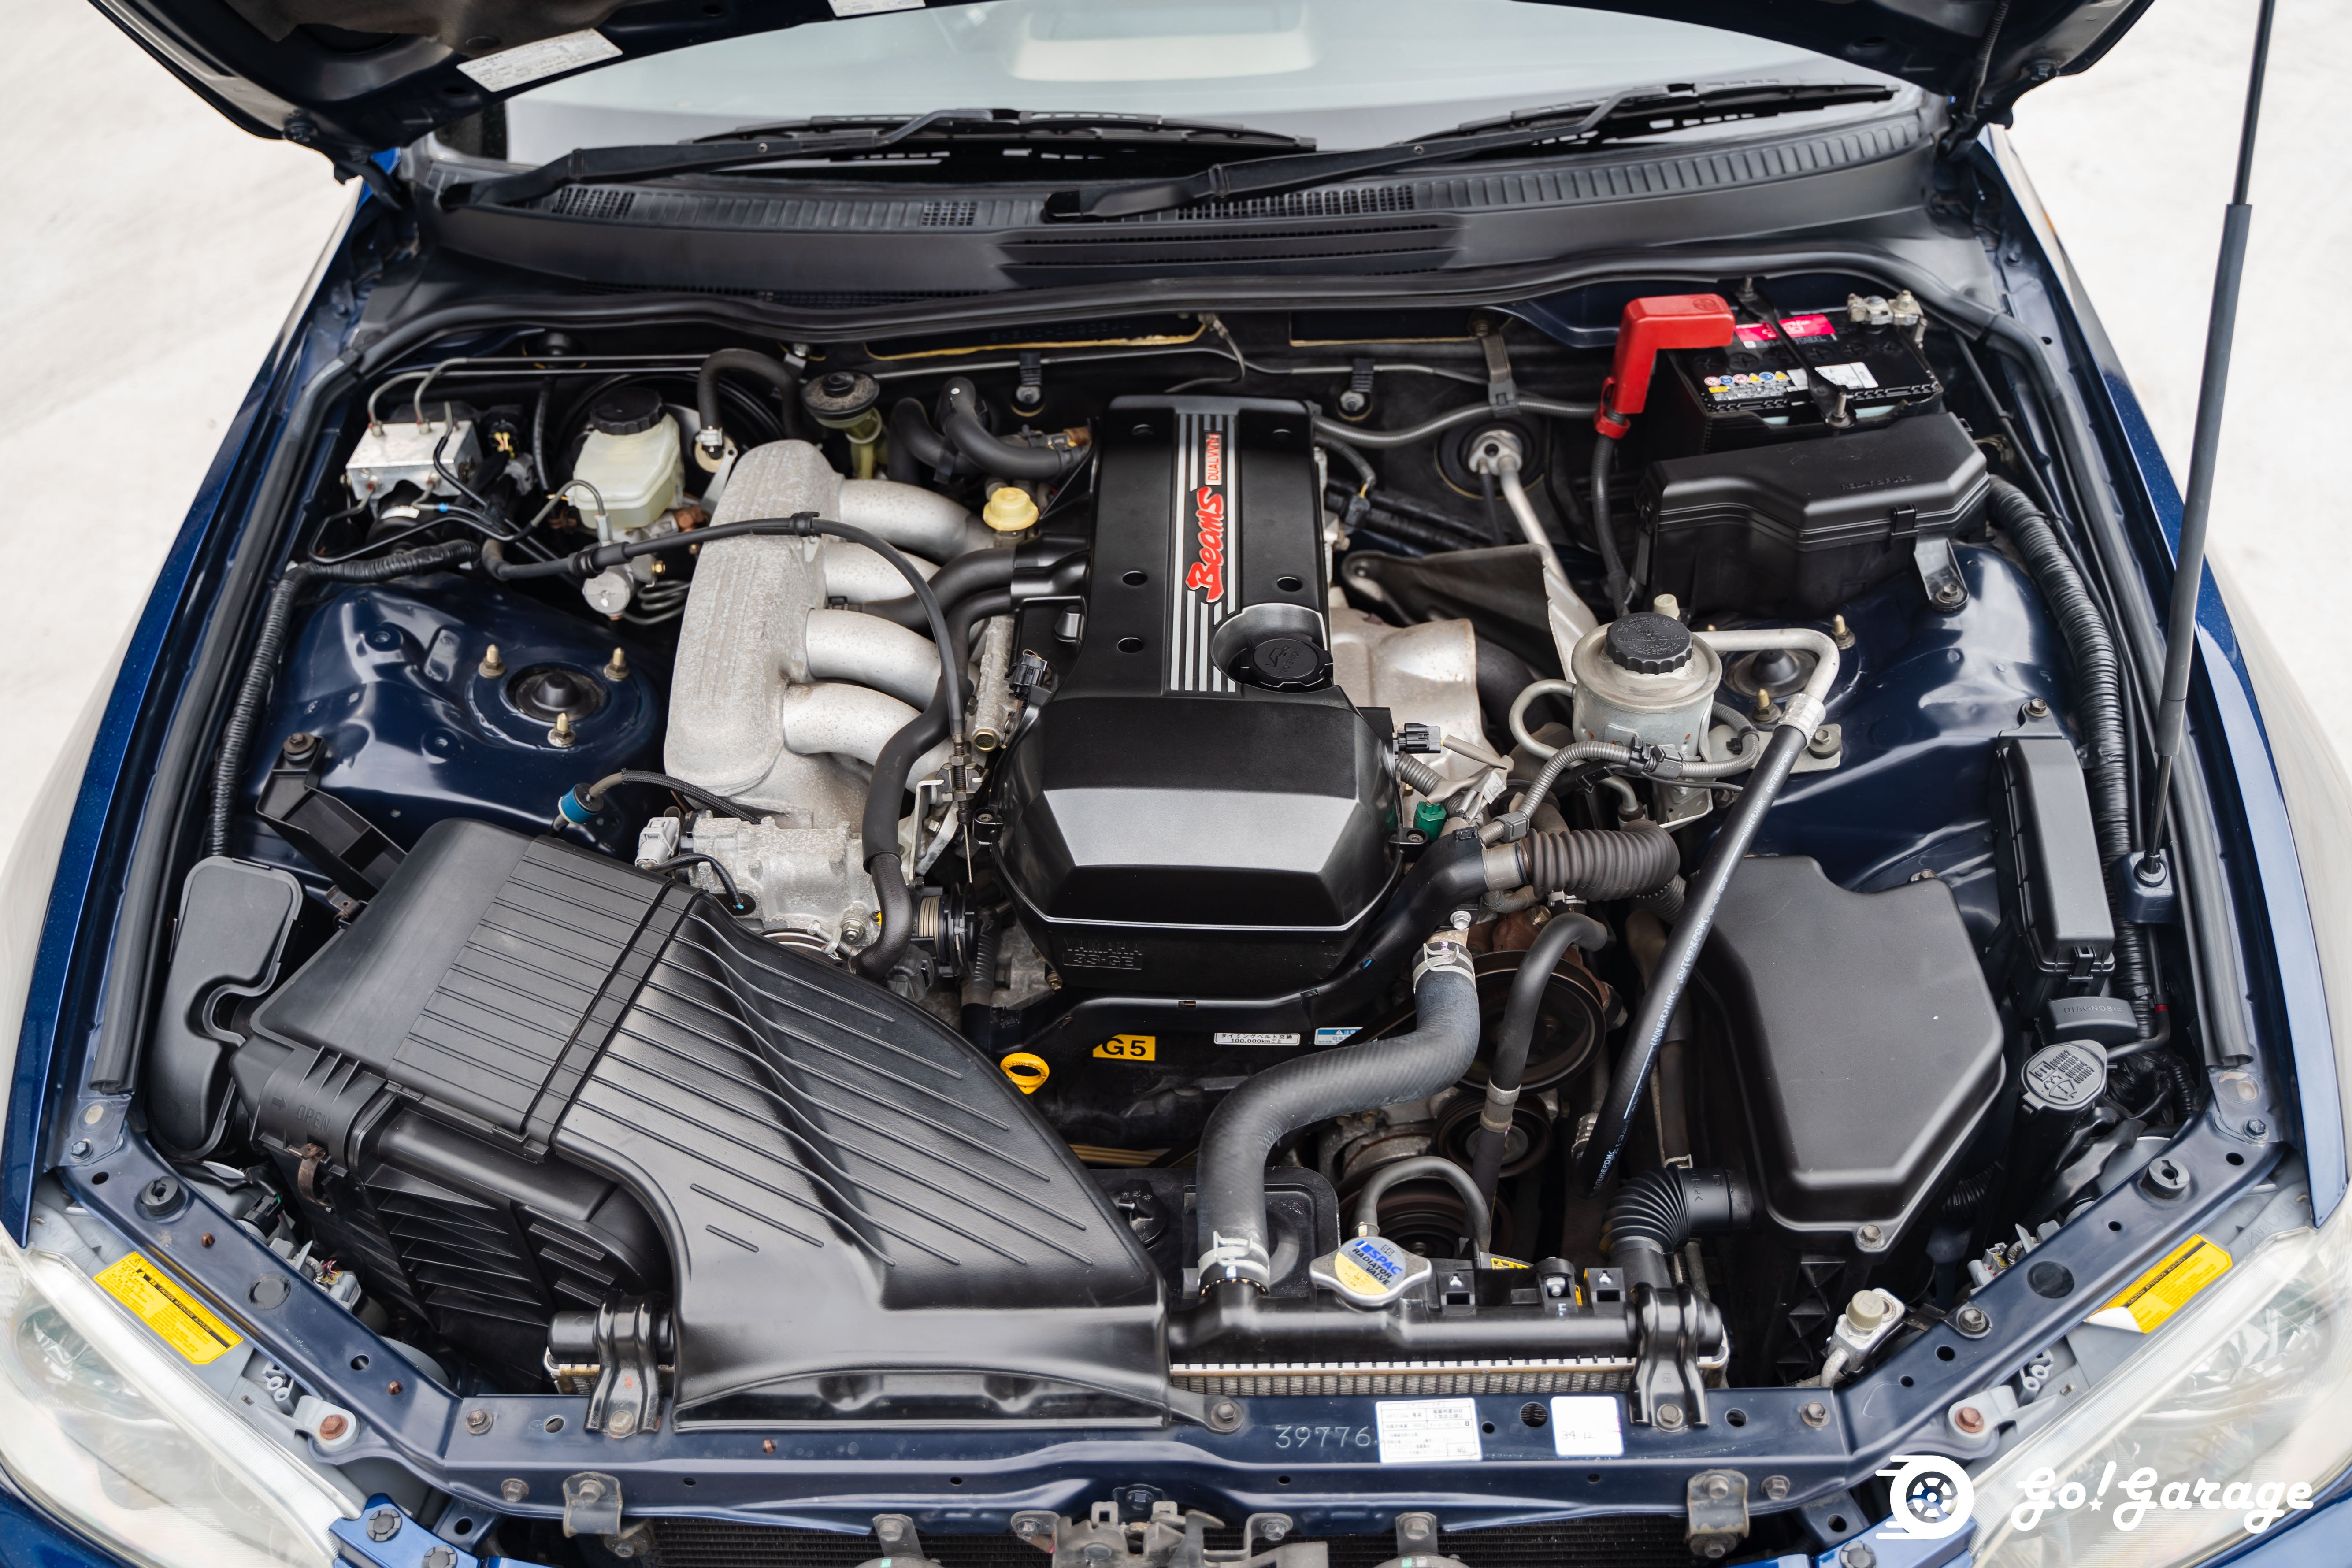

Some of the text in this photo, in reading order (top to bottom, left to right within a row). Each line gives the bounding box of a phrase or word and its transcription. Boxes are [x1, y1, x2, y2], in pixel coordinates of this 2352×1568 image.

[1208, 458, 1219, 481] DUAL
[1840, 480, 1873, 490] RELAY
[1885, 475, 1912, 484] FUSE
[1064, 938, 1143, 956] YAMAHA
[2064, 1005, 2123, 1014] DIAGNOSIS
[297, 1104, 332, 1133] OPEN
[1352, 1248, 1393, 1279] RADIATOR
[1366, 1266, 1391, 1285] VALVE
[2127, 1256, 2186, 1305] CAUTION ATTENTION ACHTUNG
[158, 1286, 175, 1301] CAUTION
[174, 1300, 195, 1318] ATTENTION
[193, 1316, 212, 1333] ACHTUNG
[1275, 1426, 1371, 1449] 39776
